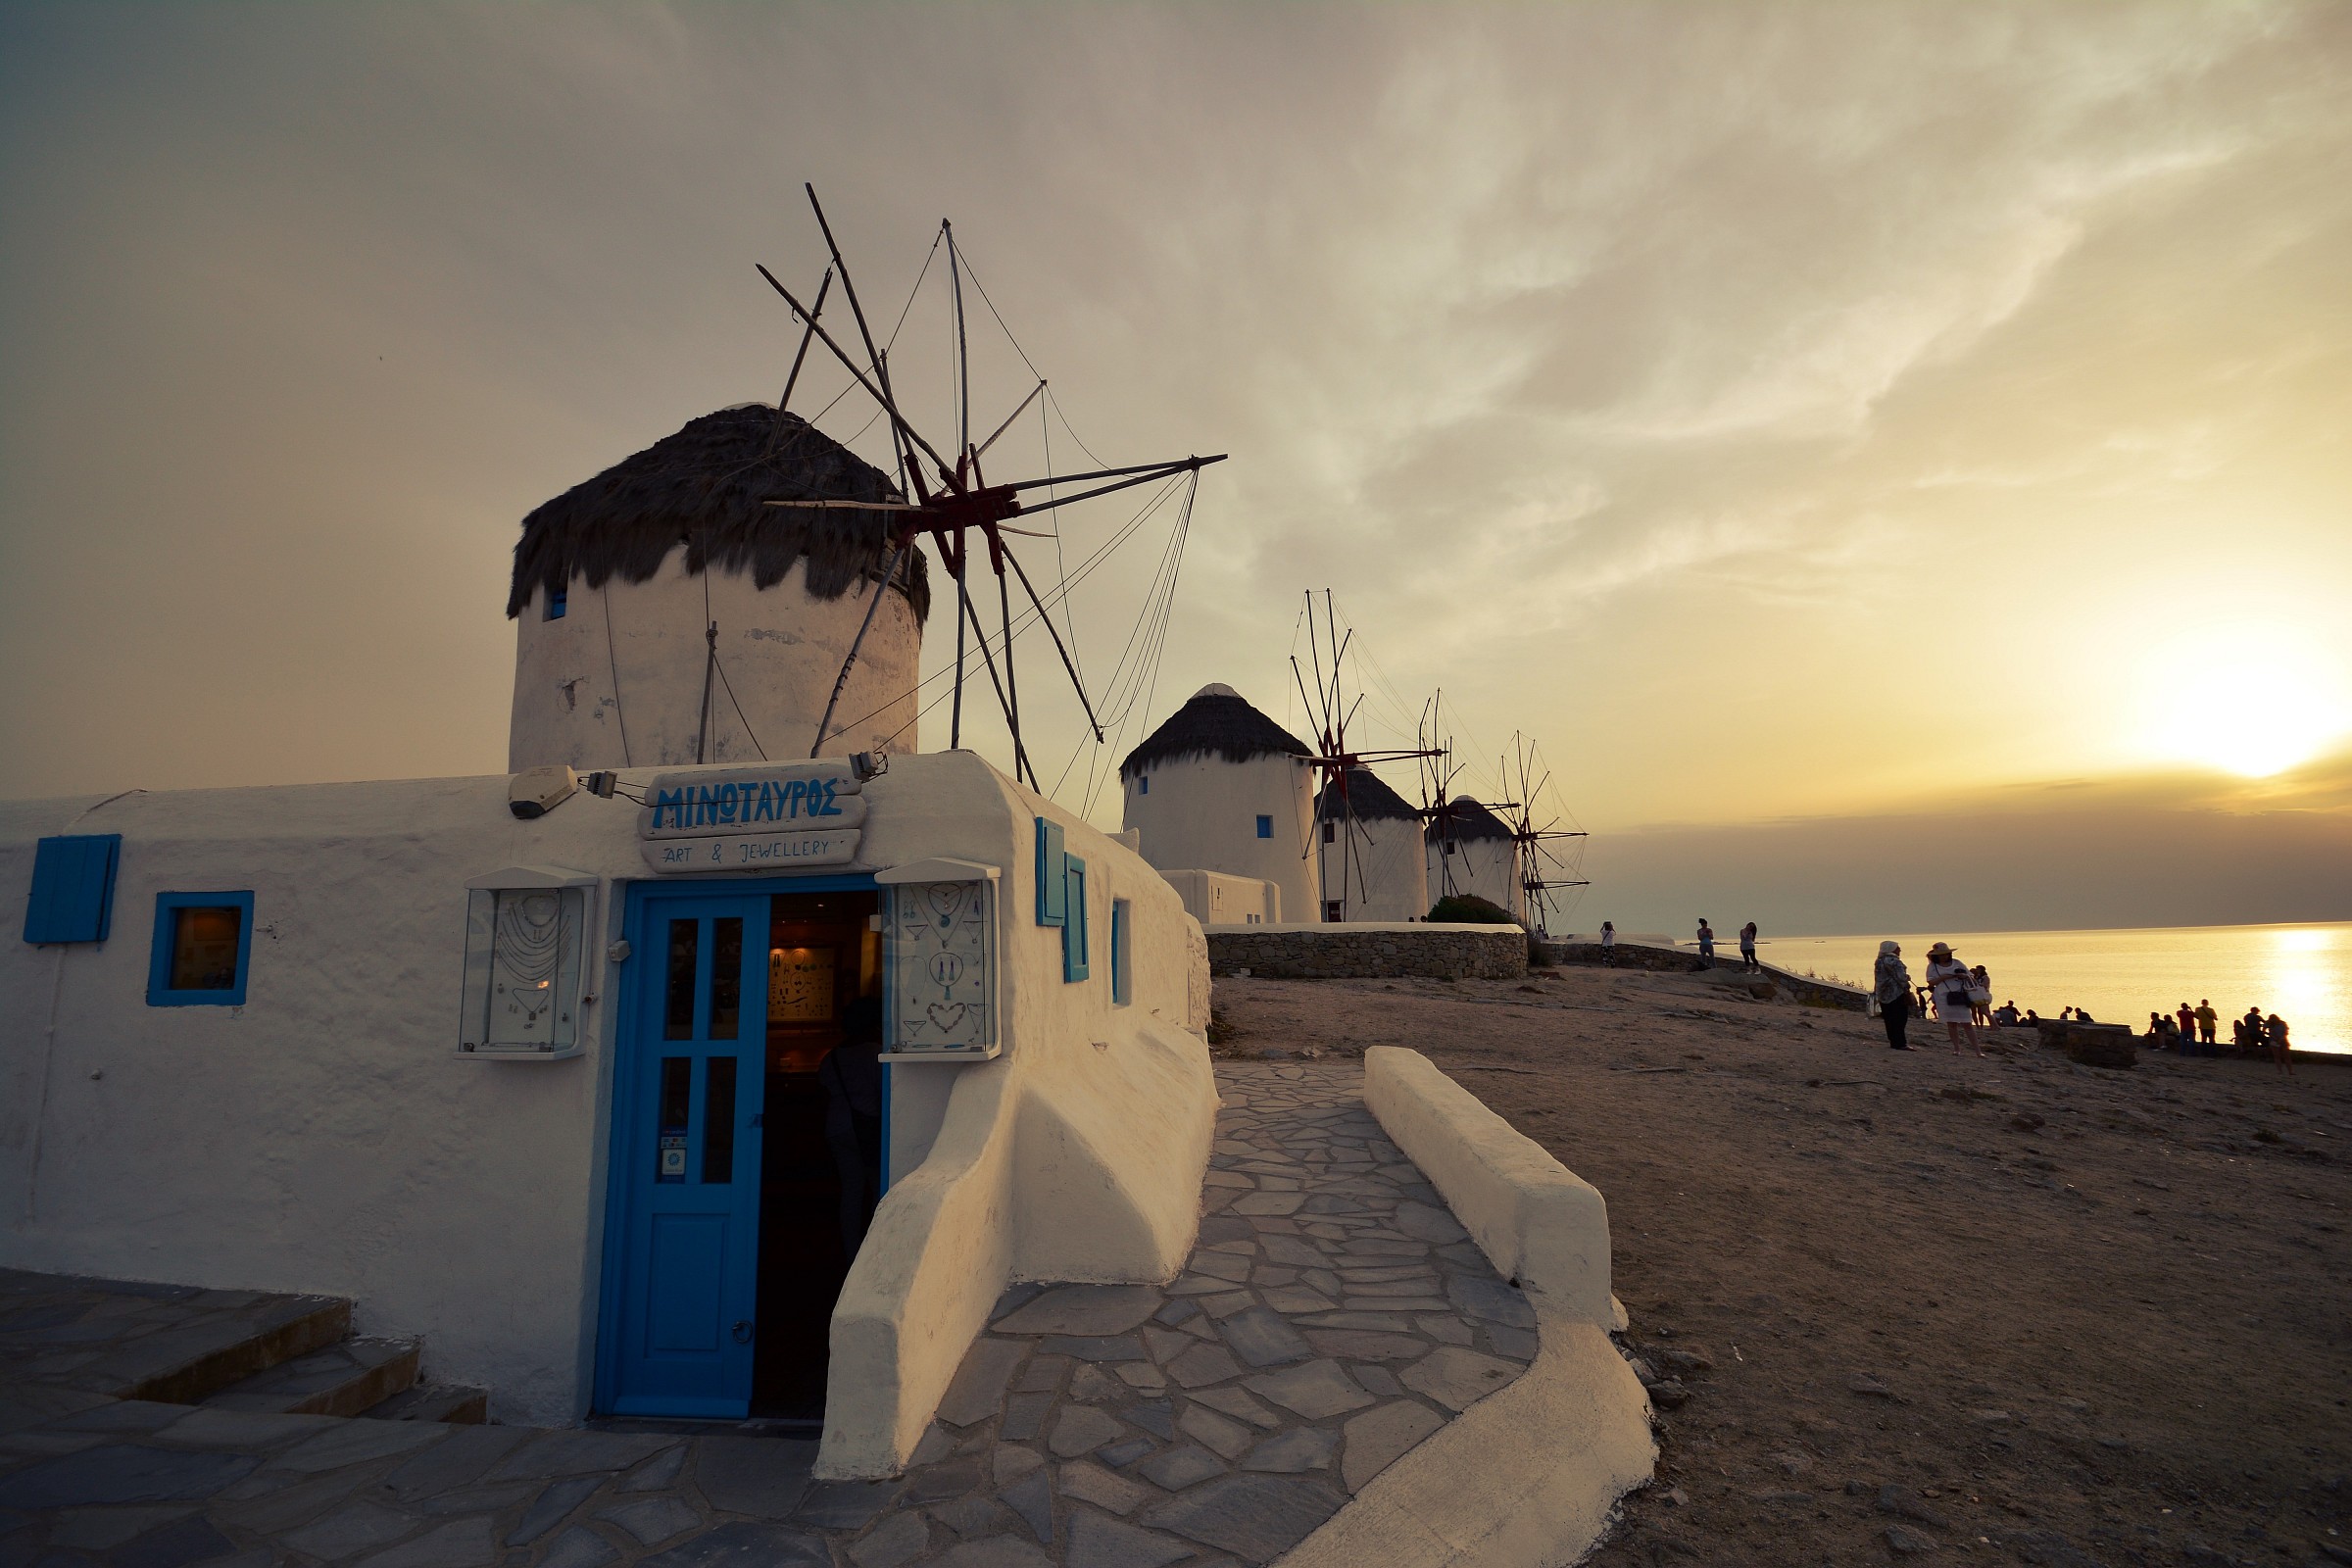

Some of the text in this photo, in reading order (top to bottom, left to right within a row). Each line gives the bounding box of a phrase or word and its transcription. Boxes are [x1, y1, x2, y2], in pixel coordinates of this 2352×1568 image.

[662, 841, 829, 864] ART & JEWELLERY
